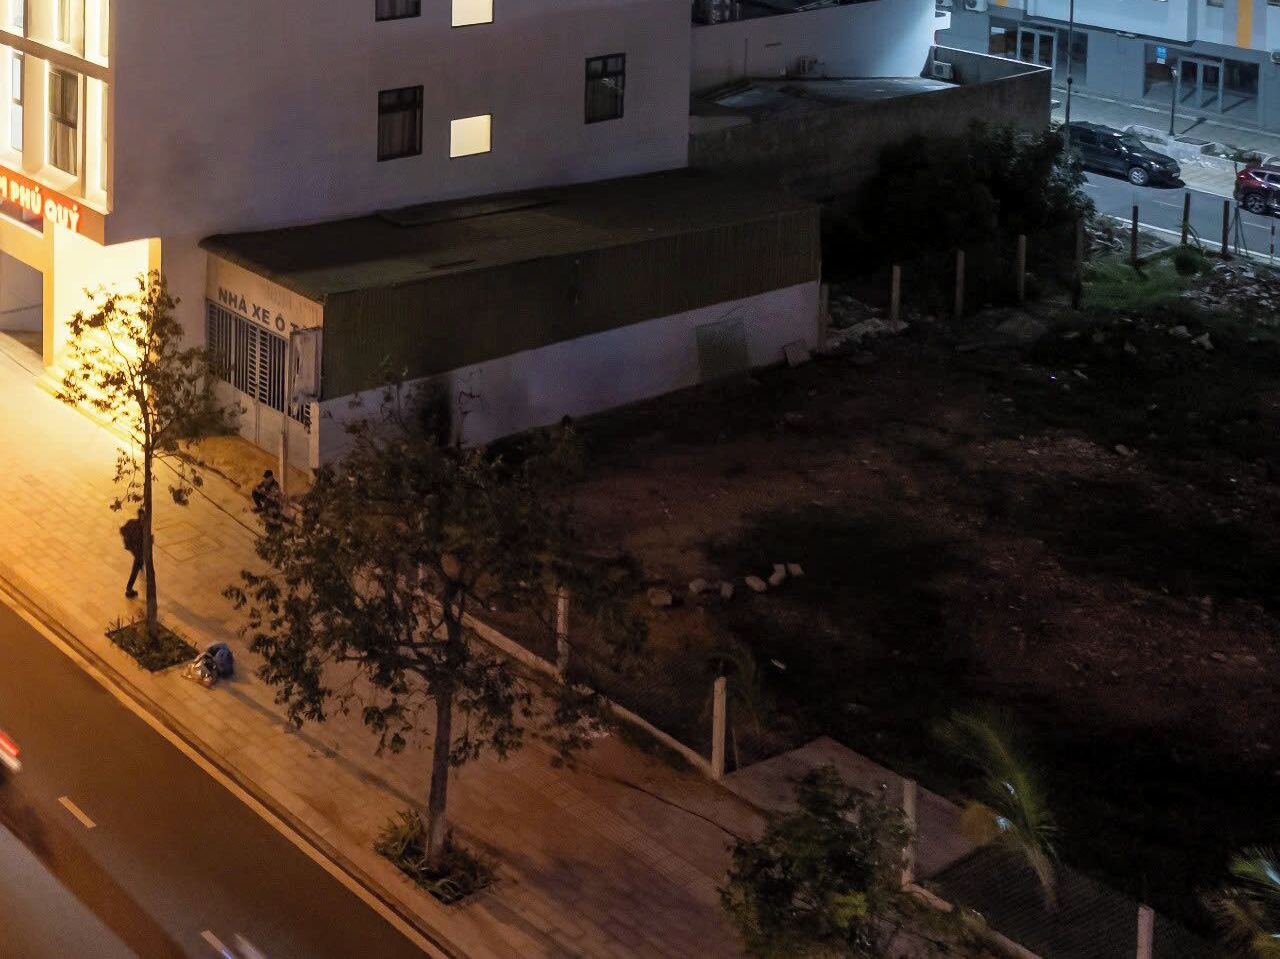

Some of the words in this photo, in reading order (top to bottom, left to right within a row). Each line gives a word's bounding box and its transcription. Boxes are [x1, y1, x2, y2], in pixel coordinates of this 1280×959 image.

[10, 181, 42, 215] PHÚ
[45, 199, 81, 233] QUÝ
[218, 287, 247, 313] NHÀ
[252, 304, 270, 325] XE
[275, 313, 286, 332] Ô
